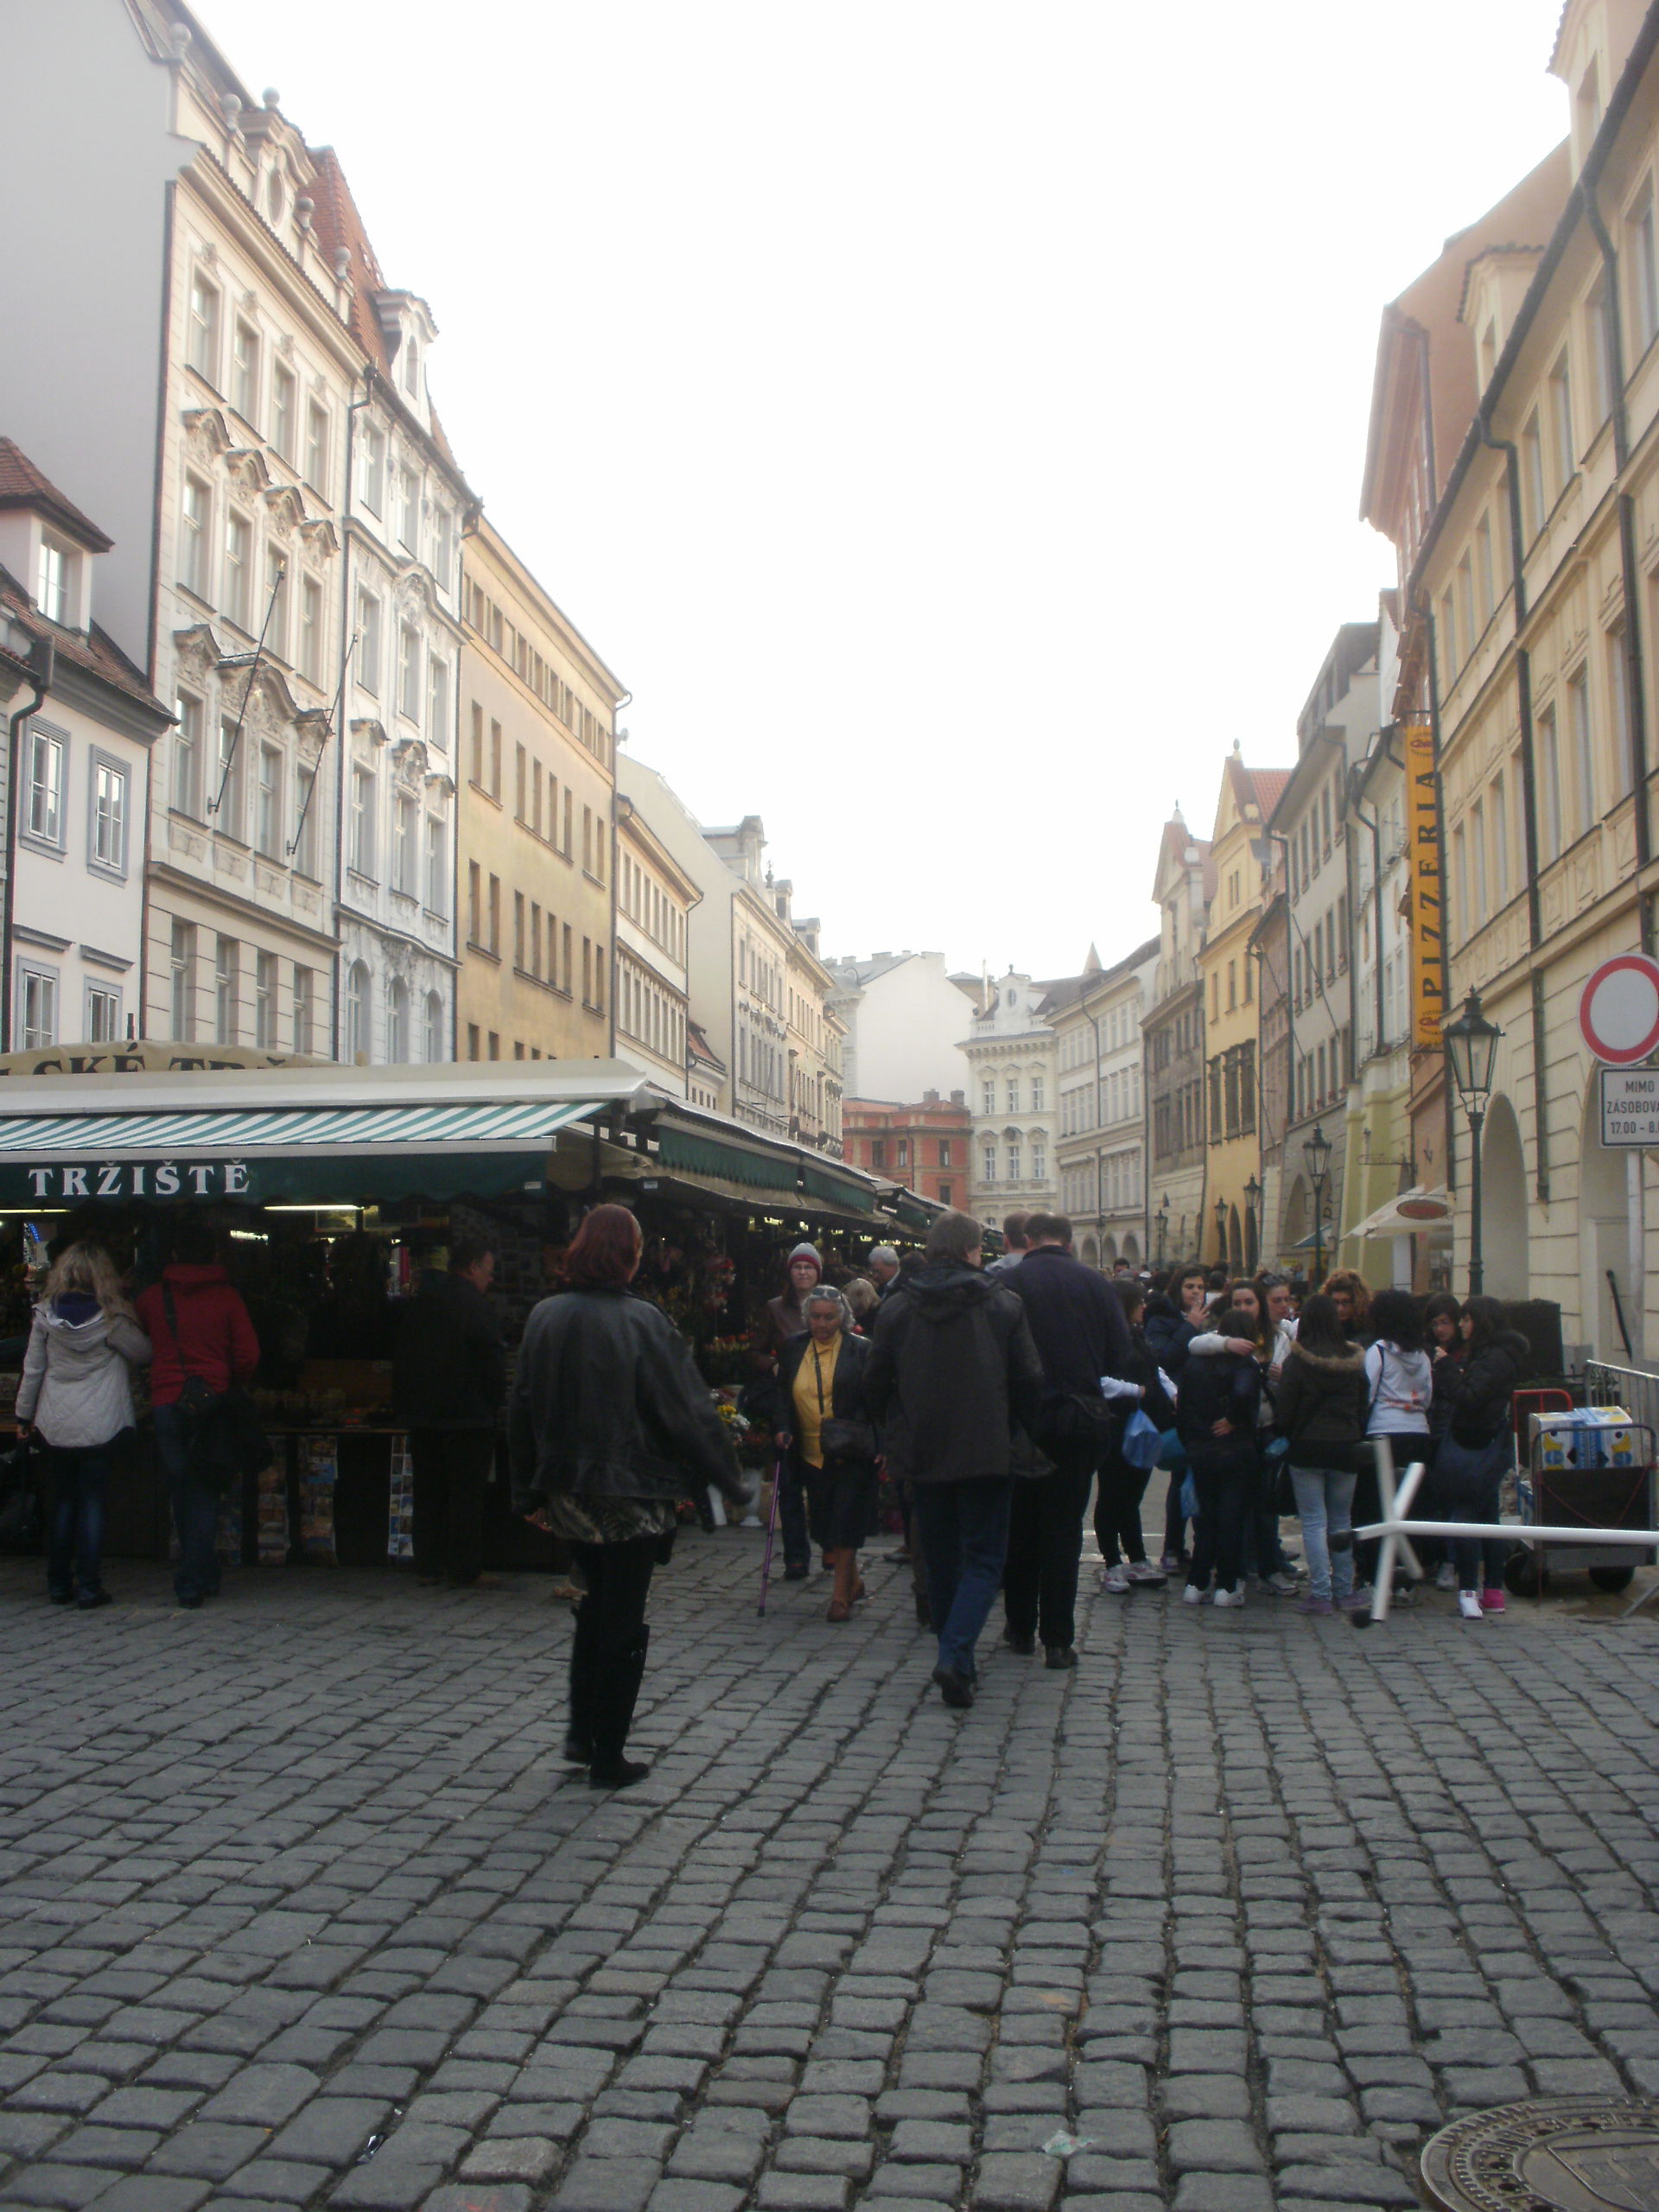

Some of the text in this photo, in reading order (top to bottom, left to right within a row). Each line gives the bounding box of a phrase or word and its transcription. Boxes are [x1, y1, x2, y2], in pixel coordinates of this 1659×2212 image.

[1414, 770, 1442, 999] PIZZERIA
[1625, 1080, 1655, 1093] MIMO
[28, 1159, 250, 1197] TRŽIŠTĚ
